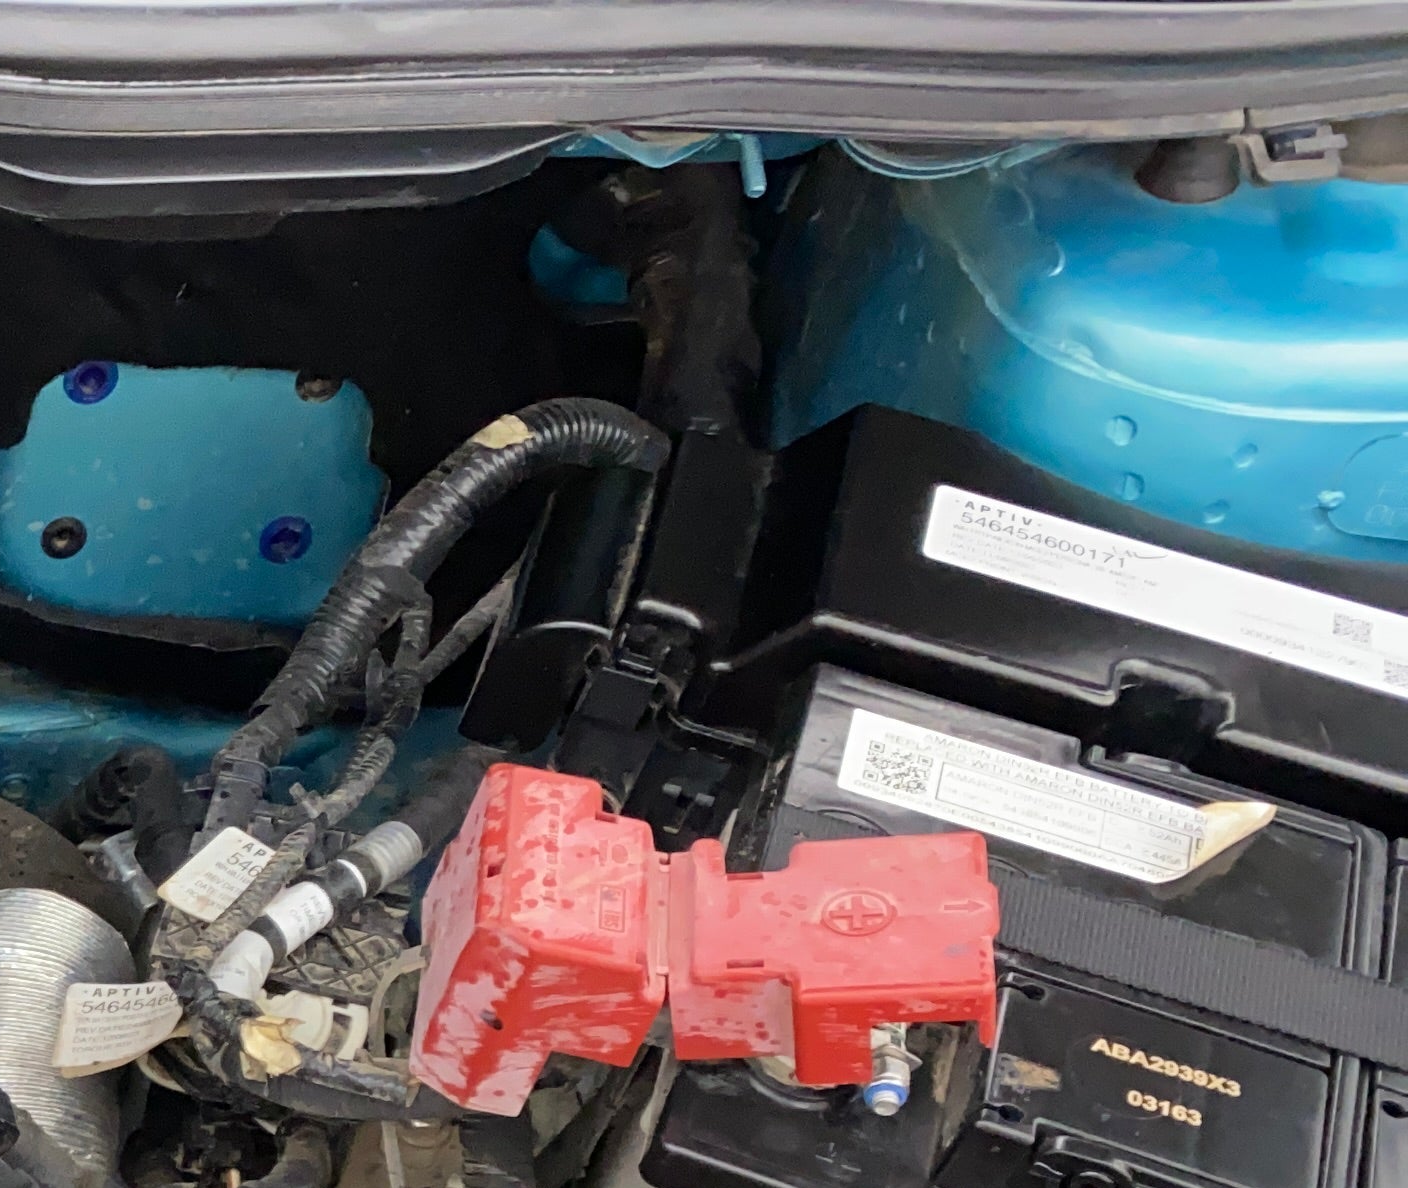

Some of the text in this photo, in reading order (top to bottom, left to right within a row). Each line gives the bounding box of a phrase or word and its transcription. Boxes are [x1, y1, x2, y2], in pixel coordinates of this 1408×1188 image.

[964, 500, 1033, 526] APTIV
[960, 511, 1127, 569] 546454600171
[923, 733, 992, 761] AMARON
[1088, 781, 1164, 812] BATTERY
[1014, 770, 1084, 800] AMARON
[91, 986, 157, 998] APTIV
[1089, 1037, 1243, 1098] ABA2939X3
[1125, 1089, 1204, 1128] 03163
